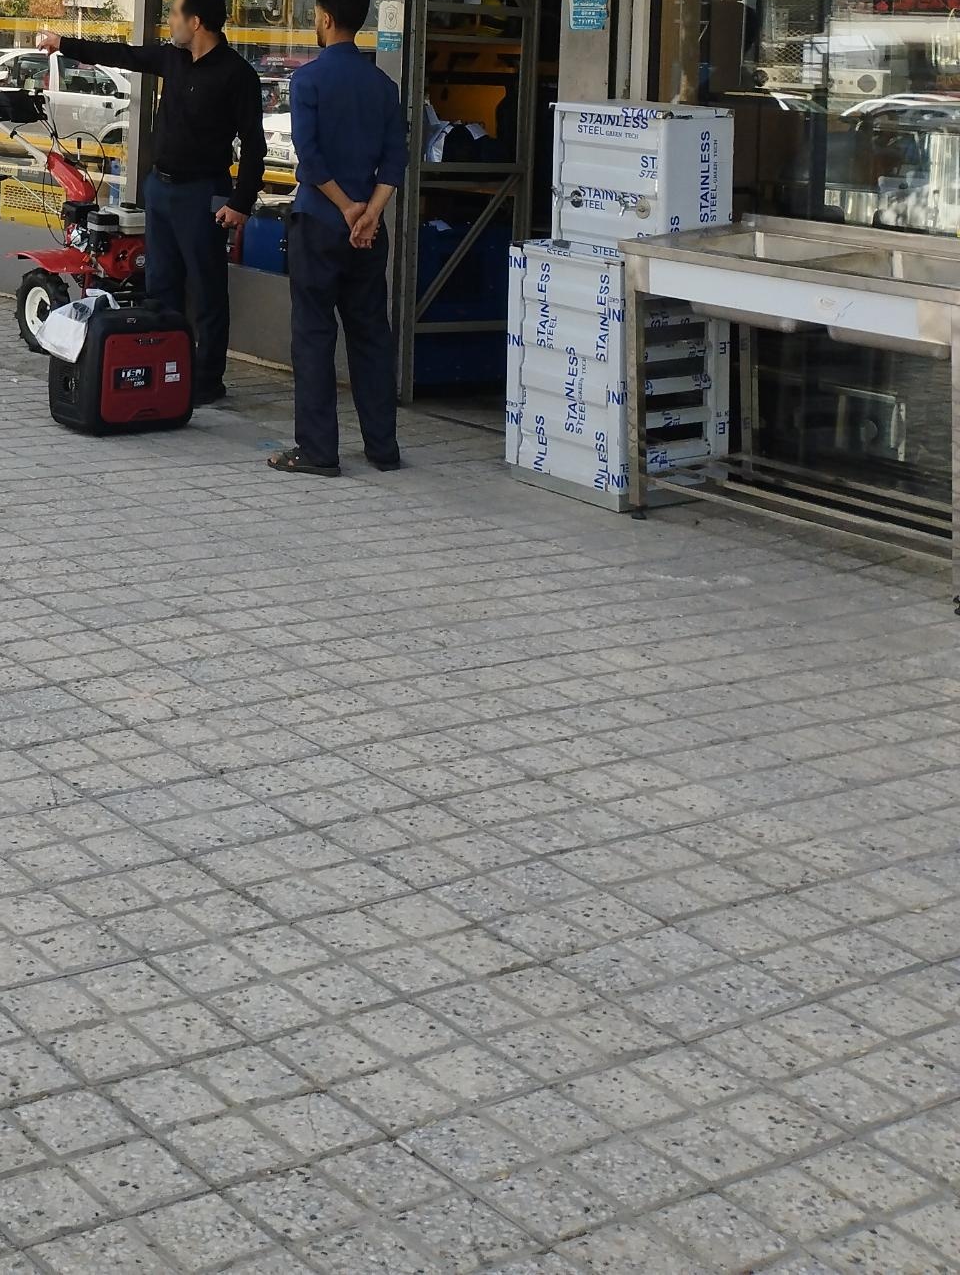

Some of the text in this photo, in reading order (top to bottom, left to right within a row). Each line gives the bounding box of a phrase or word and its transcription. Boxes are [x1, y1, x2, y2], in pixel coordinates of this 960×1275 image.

[577, 125, 604, 136] STEEL
[579, 112, 649, 130] STAINLESS
[700, 130, 710, 223] STAINLESS
[582, 198, 606, 211] TEEL
[710, 187, 718, 222] STEEL
[592, 245, 619, 258] STEEL
[537, 262, 551, 347] STAINLESS
[596, 274, 610, 363] STAINLESS
[547, 316, 557, 350] STEEL
[565, 346, 579, 433] STAINLESS
[576, 401, 586, 435] STEEL
